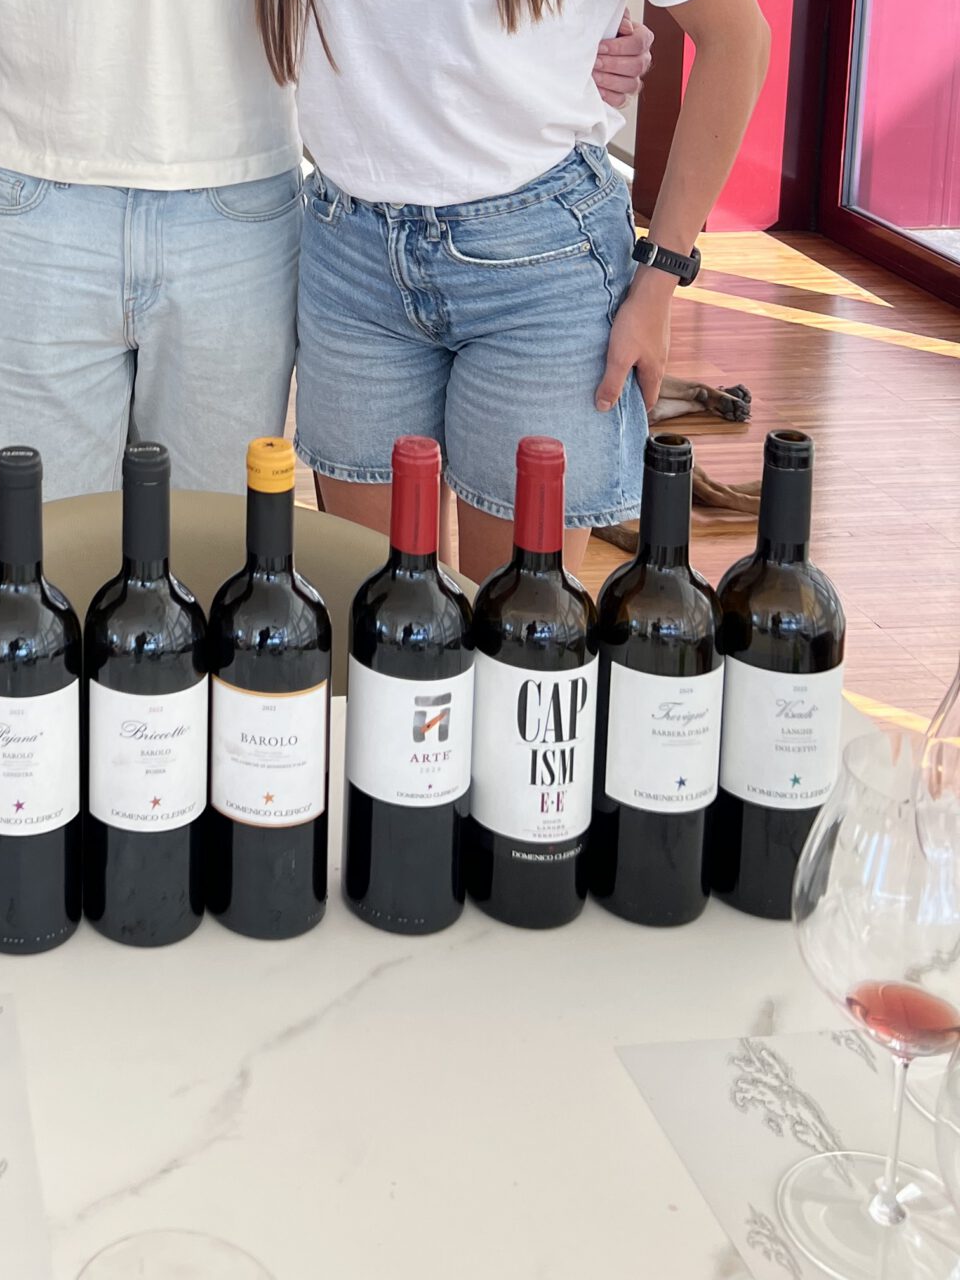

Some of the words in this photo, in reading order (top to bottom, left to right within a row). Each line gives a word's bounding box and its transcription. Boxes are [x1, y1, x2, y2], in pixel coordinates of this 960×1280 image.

[517, 677, 588, 743] CAP
[241, 732, 298, 747] BAROLO
[140, 748, 171, 756] BAROLO
[410, 751, 450, 763] ARTE
[529, 746, 575, 786] ISM
[634, 789, 683, 802] DOMENICO
[746, 784, 798, 800] DOMENICO
[111, 808, 158, 821] DOMENICO
[160, 803, 194, 821] CLERICO
[226, 800, 271, 817] DOMENICO
[273, 803, 310, 817] CLERICO
[24, 810, 61, 825] CLERICO
[512, 849, 553, 861] DOMENICO
